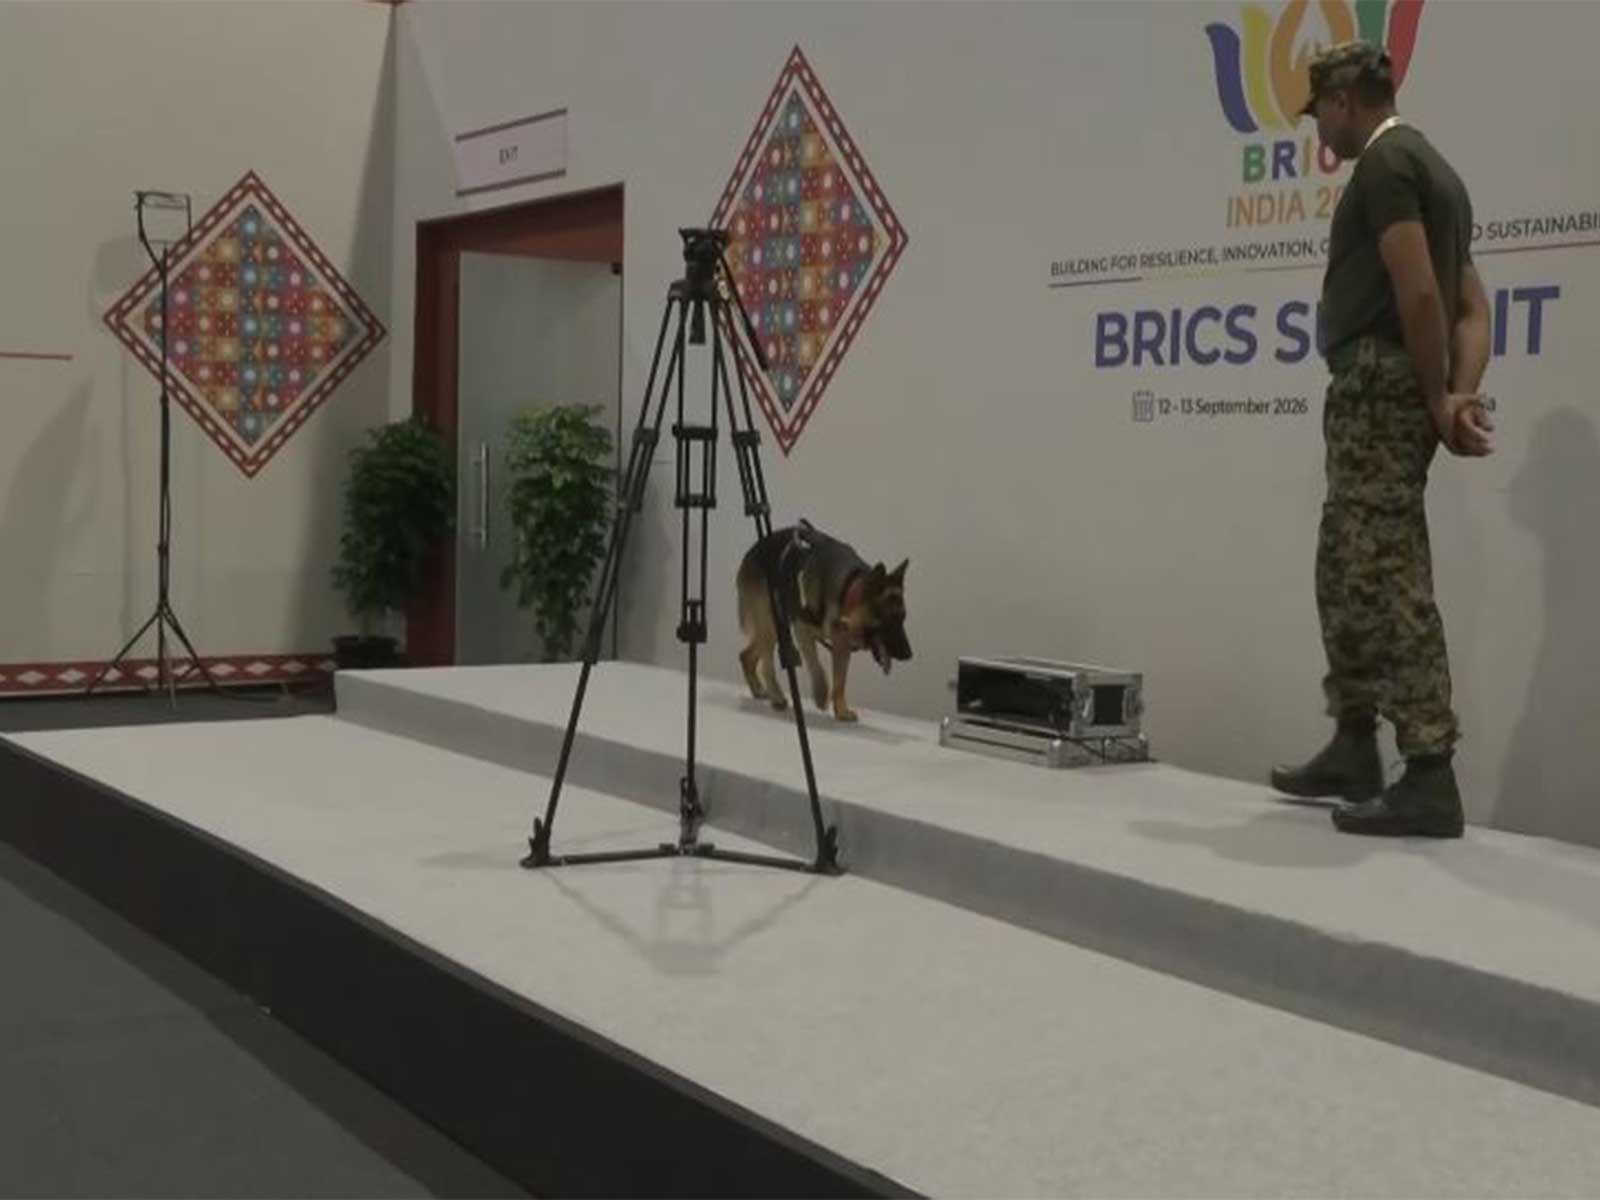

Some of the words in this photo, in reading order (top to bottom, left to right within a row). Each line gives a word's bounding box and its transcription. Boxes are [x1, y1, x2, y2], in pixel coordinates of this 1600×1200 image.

[1243, 136, 1343, 183] BRIC
[1226, 190, 1306, 227] INDIA
[1487, 210, 1600, 240] SUSTAINABI
[1050, 257, 1108, 276] BUILDING
[1110, 253, 1137, 272] FOR
[1140, 246, 1219, 269] RESILIENCE,
[1223, 239, 1318, 261] INNOVATION,
[1095, 304, 1258, 368] BRICS
[1158, 398, 1171, 414] 12
[1180, 398, 1194, 414] 13
[1195, 398, 1269, 418] September
[1273, 397, 1308, 414] 2026
